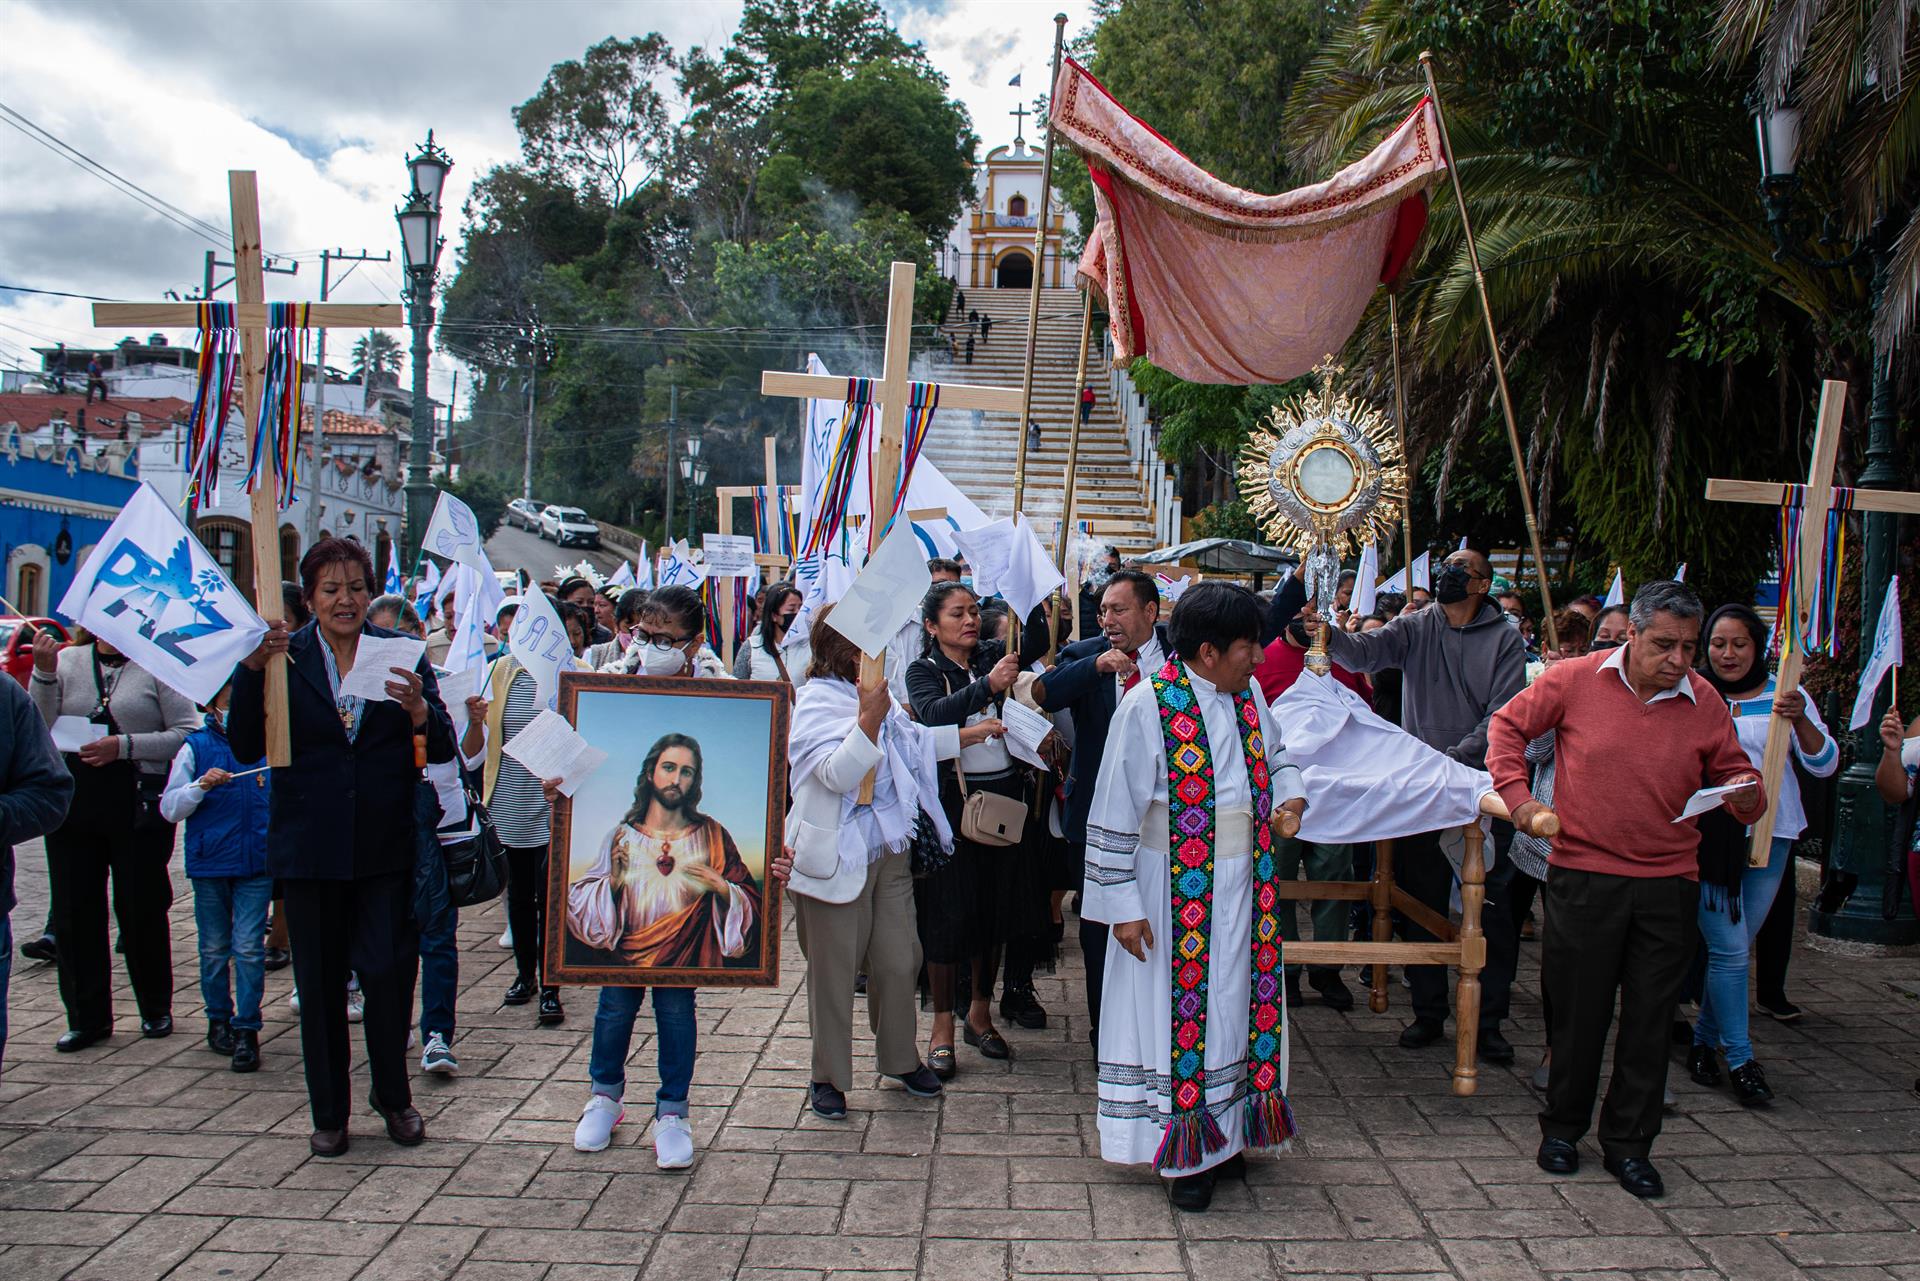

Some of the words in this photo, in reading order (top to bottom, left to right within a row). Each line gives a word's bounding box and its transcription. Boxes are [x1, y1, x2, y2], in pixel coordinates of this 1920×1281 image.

[662, 555, 699, 586] PAZ
[90, 537, 234, 667] PAZ
[513, 604, 566, 662] PAZ
